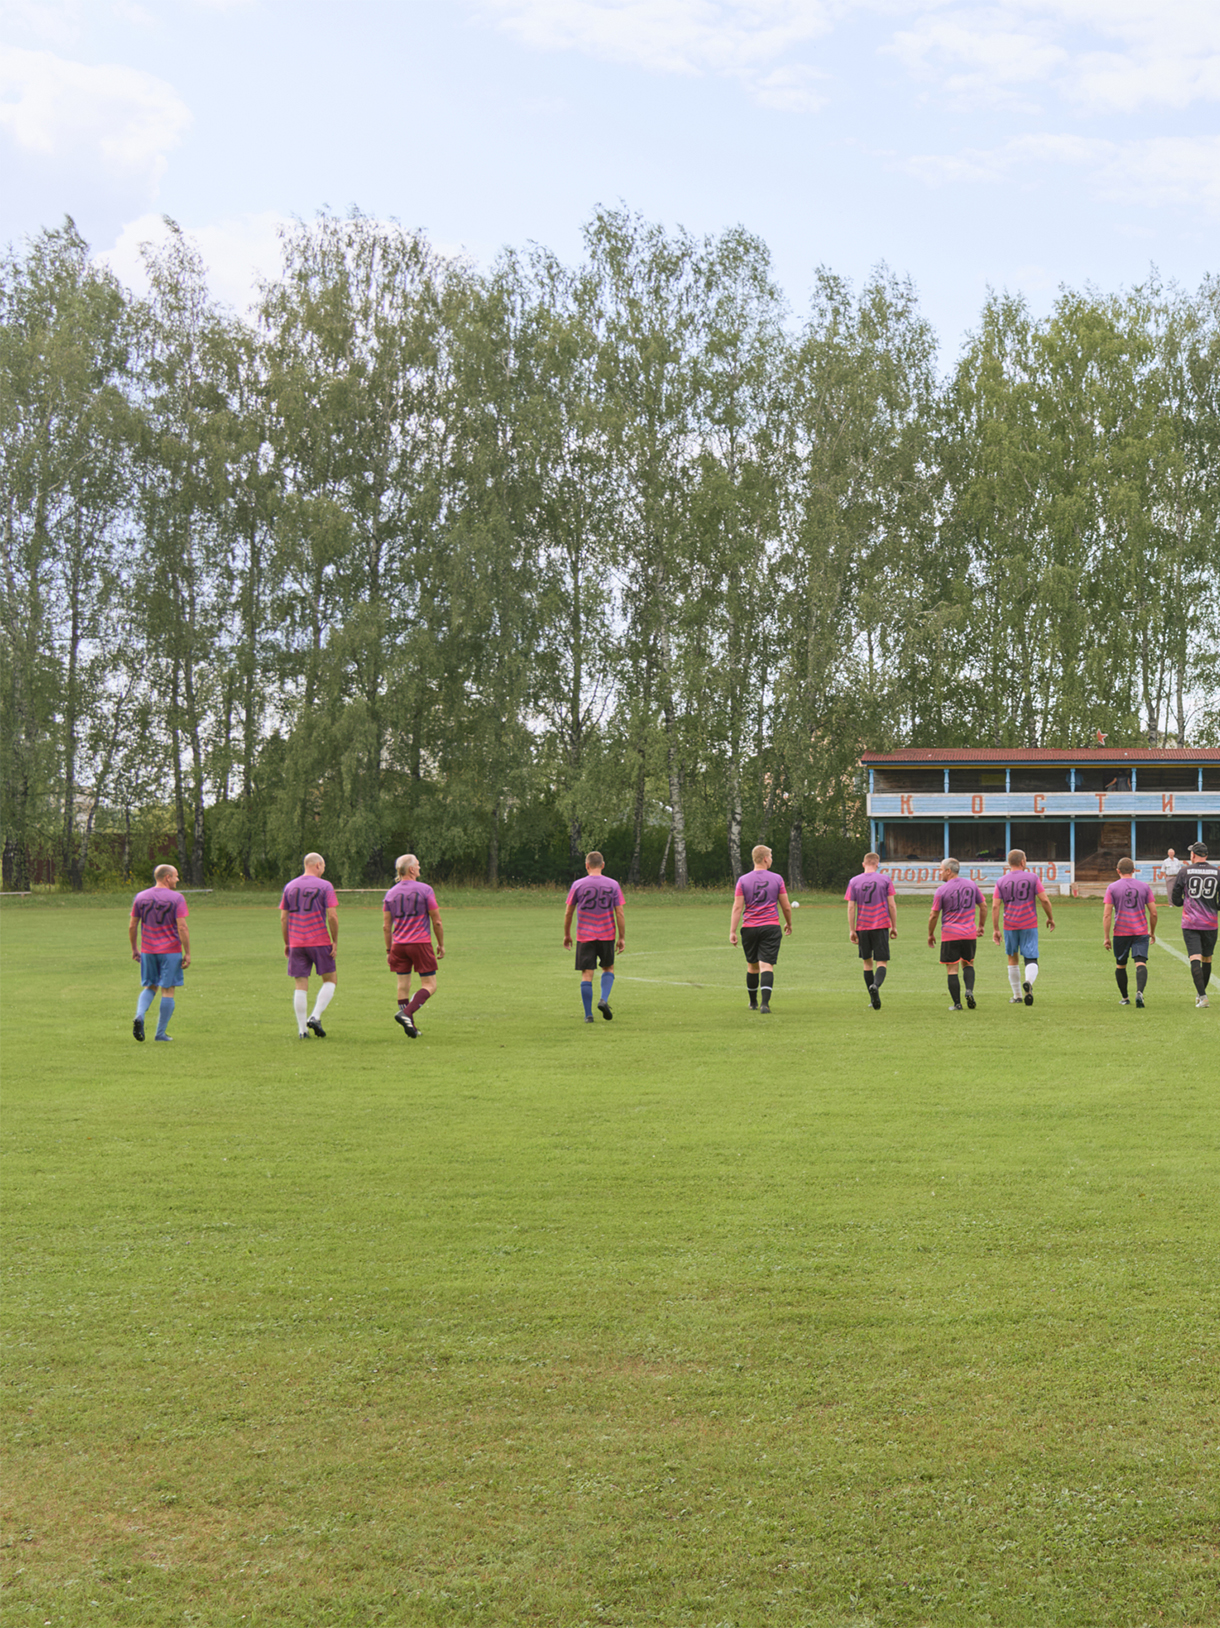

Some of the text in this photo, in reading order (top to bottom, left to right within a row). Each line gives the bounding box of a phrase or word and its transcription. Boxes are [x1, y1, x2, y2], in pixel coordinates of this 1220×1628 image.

[969, 865, 988, 881] и
[1003, 861, 1056, 883] уд
[581, 886, 613, 910] 25
[753, 880, 769, 903] 5
[862, 881, 877, 904] 7
[1004, 879, 1031, 902] 18
[1124, 887, 1139, 909] 3
[1188, 876, 1218, 899] 99
[289, 887, 321, 912] 17
[394, 892, 419, 918] 11
[949, 886, 974, 913] 18
[140, 899, 174, 924] 77
